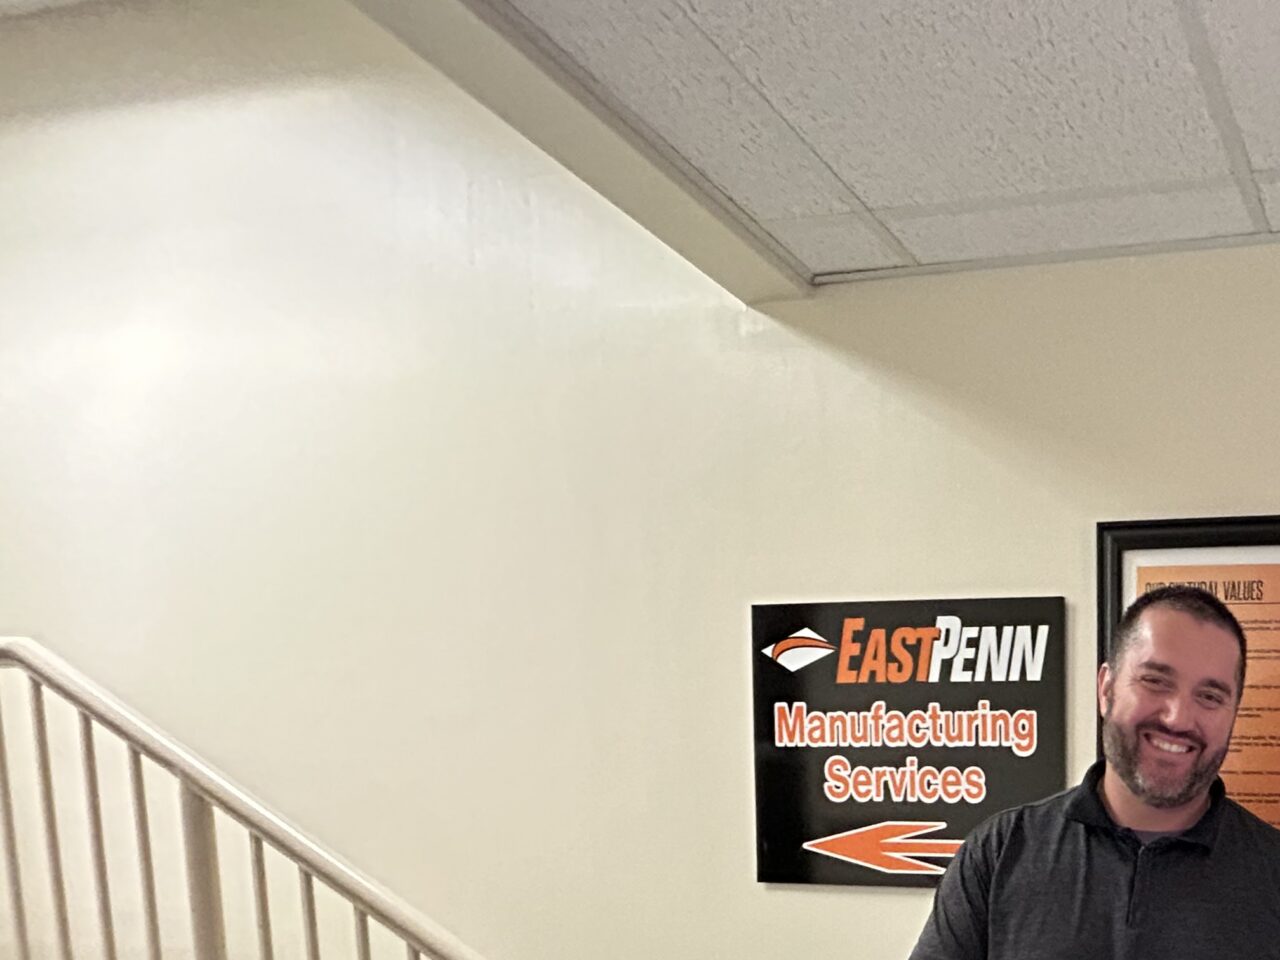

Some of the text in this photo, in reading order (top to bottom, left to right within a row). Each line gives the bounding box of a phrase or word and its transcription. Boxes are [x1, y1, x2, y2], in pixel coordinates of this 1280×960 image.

[1223, 579, 1264, 601] VALUES
[774, 700, 1037, 757] Manufacturing
[823, 755, 986, 804] Services
